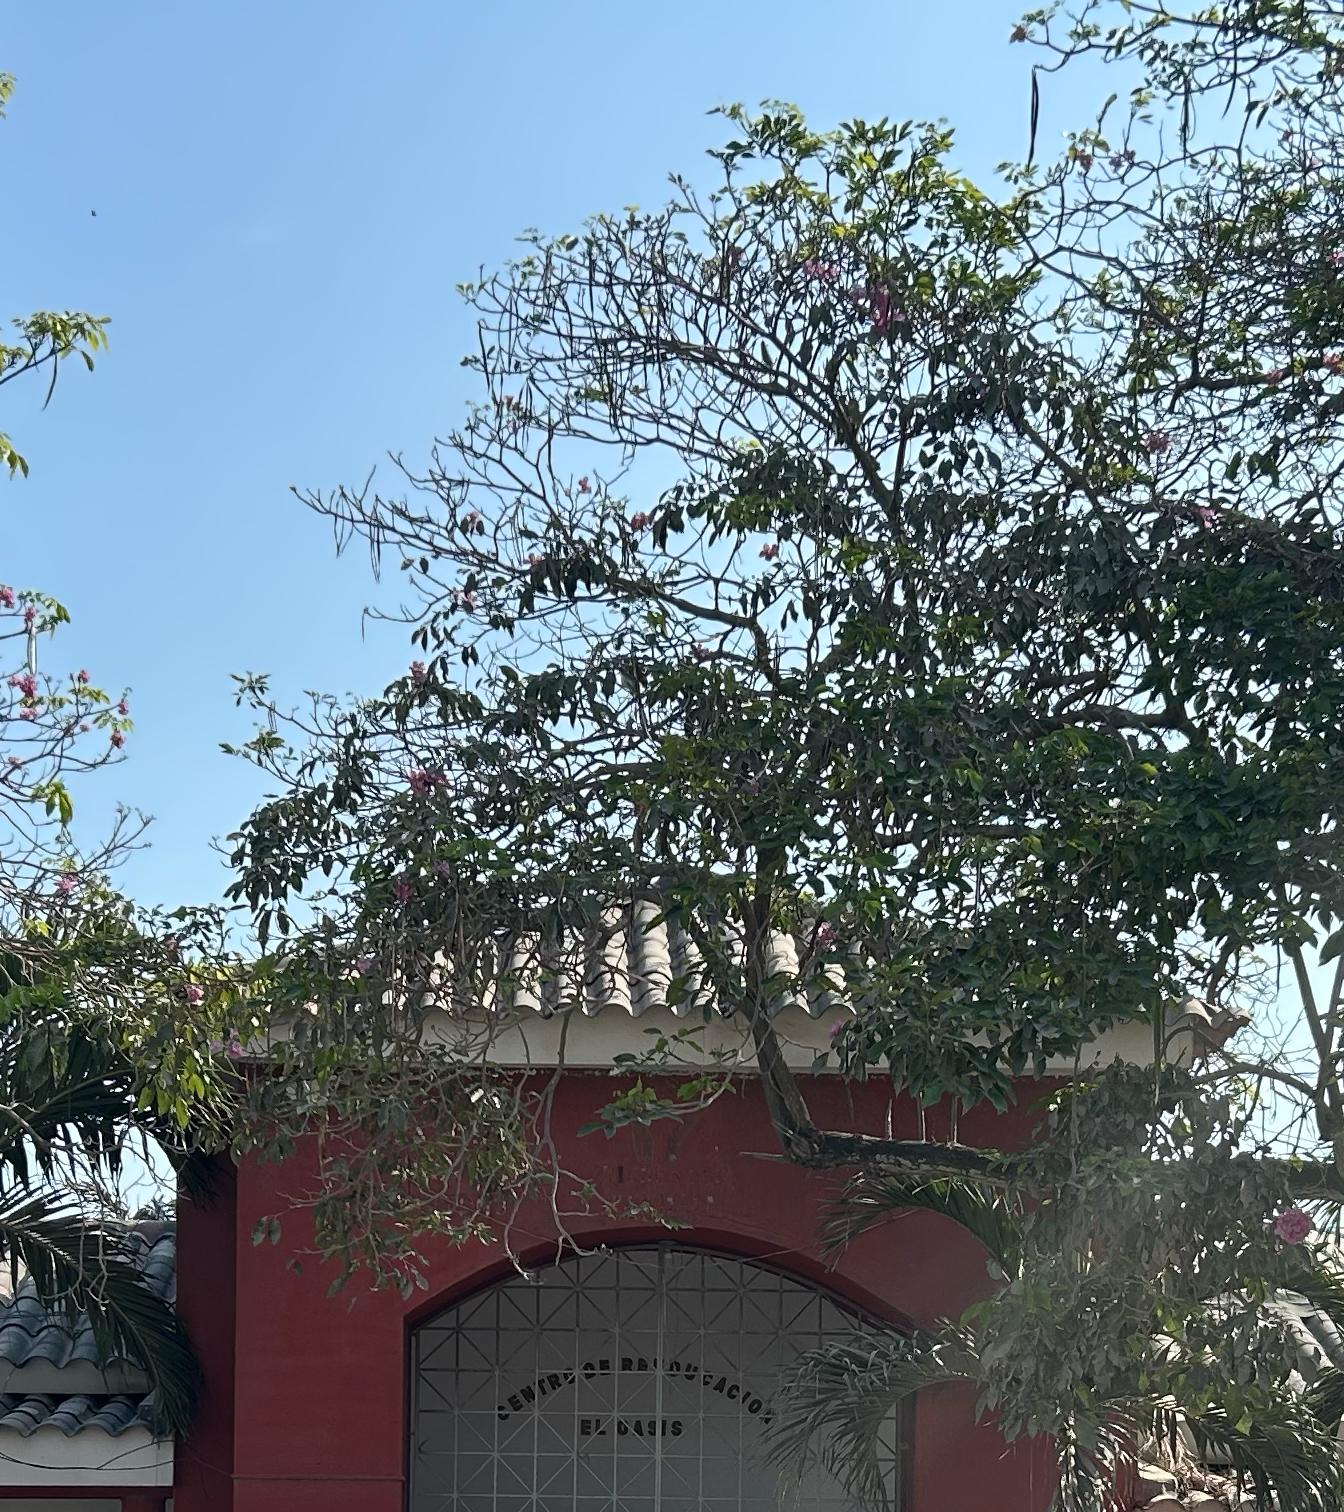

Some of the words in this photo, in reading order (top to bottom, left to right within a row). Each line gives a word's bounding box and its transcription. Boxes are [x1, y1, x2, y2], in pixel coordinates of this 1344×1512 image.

[497, 1367, 577, 1421] CENTRO
[582, 1360, 611, 1379] DE
[580, 1419, 607, 1436] EL
[617, 1419, 683, 1437] OASIS
